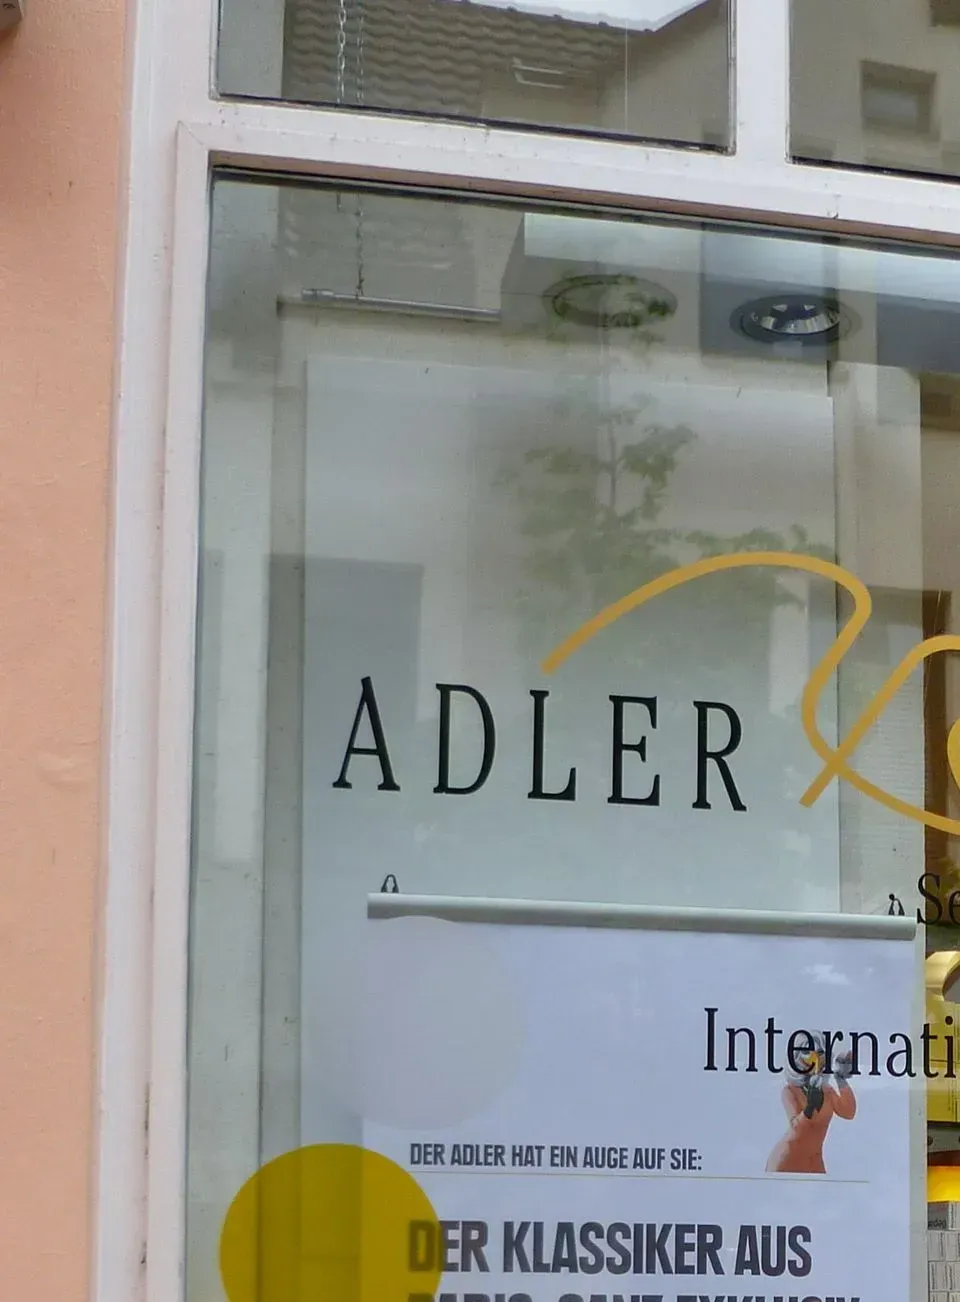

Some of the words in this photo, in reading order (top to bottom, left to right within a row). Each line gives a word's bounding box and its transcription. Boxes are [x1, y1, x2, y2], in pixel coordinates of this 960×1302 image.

[332, 675, 747, 812] ADLER
[410, 1143, 448, 1167] DER
[450, 1144, 506, 1168] ADLER
[511, 1145, 545, 1168] HAT
[550, 1145, 578, 1168] EIN
[583, 1146, 629, 1170] AUGE
[632, 1147, 666, 1170] AUF
[669, 1147, 703, 1171] SIE:
[408, 1219, 490, 1273] DER
[502, 1220, 724, 1276] KLASSIKER
[733, 1225, 813, 1278] AUS
